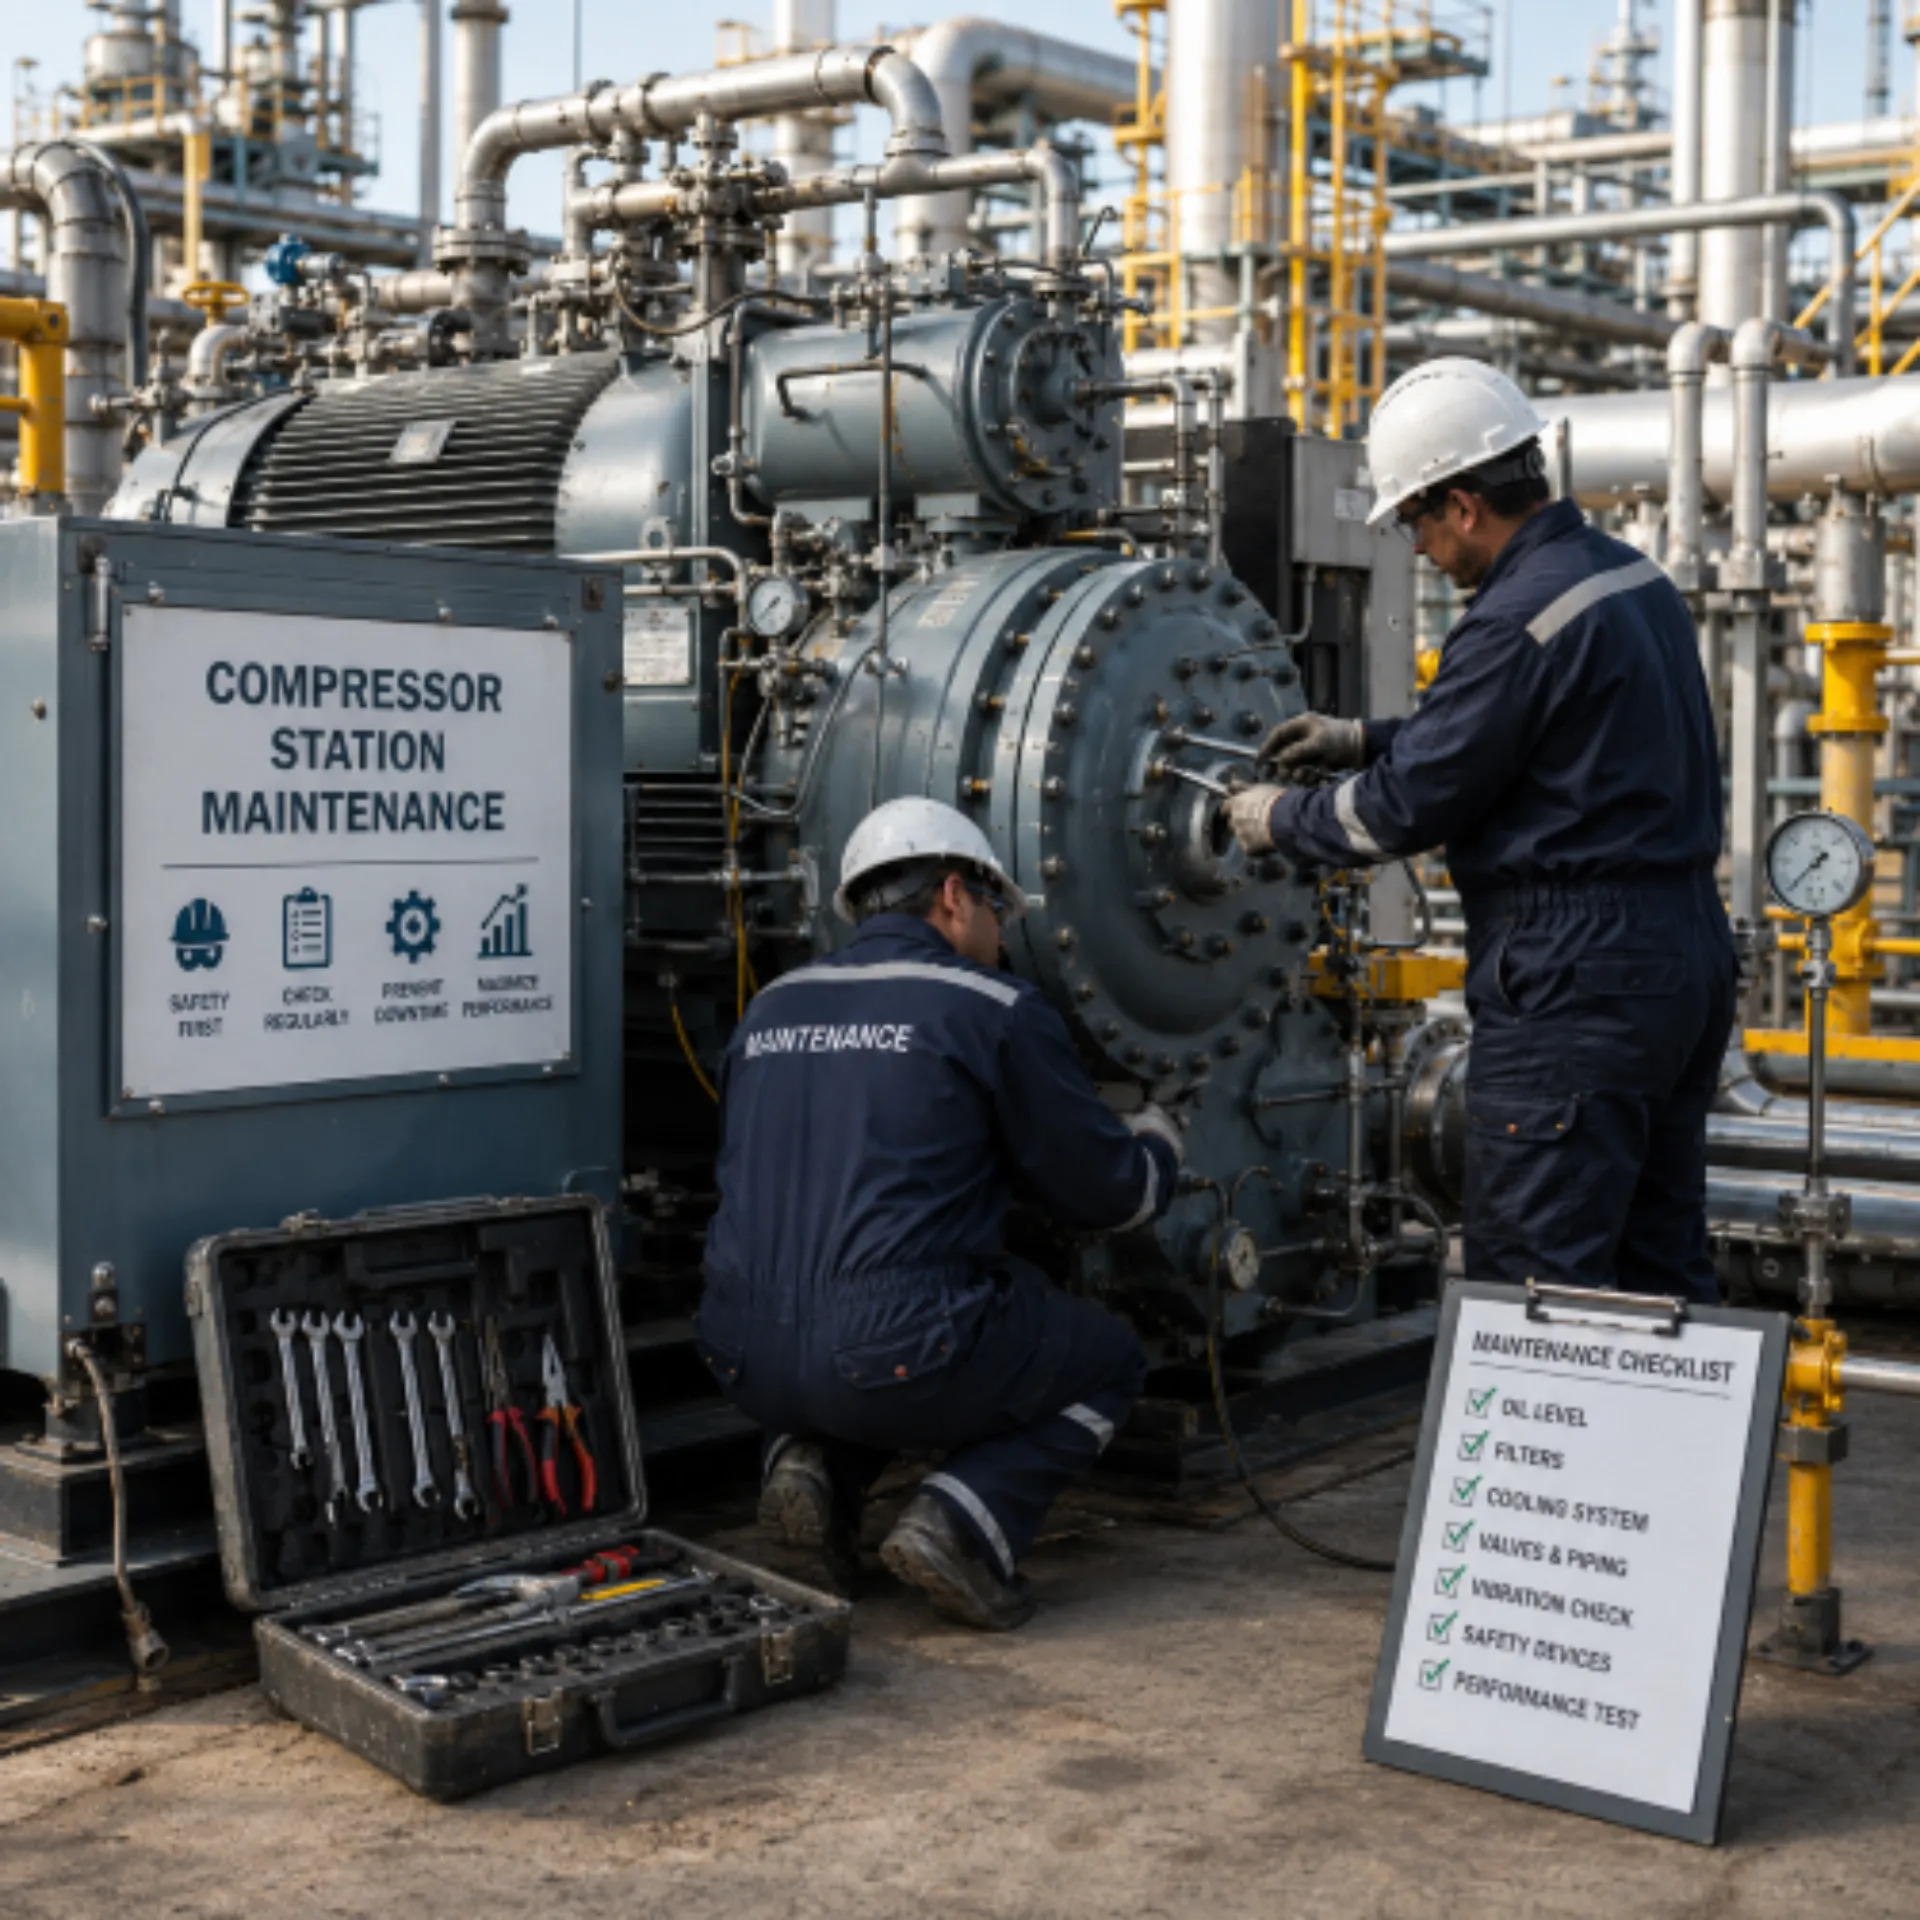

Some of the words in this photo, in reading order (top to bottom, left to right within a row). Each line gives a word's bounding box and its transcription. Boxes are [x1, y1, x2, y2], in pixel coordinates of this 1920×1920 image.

[205, 660, 503, 713] COMPRESSOR
[270, 727, 446, 773] STATION
[201, 790, 506, 835] MAINTENANCE
[168, 990, 230, 1014] SAFETY
[745, 1023, 914, 1060] MAINTENANCE
[1472, 1330, 1615, 1370] MAINTENANCE
[1617, 1349, 1736, 1384] CHECKLIST
[1502, 1397, 1529, 1420] OIL
[1533, 1402, 1588, 1428] LEVEL
[1494, 1441, 1565, 1471] FILTERS
[1487, 1486, 1568, 1519] COOLING
[1572, 1502, 1650, 1533] SYSTEM
[1479, 1532, 1546, 1562] VALVES
[1549, 1545, 1562, 1566] &
[1567, 1548, 1628, 1578] PIPING
[1472, 1577, 1565, 1614] VIBRATION
[1571, 1597, 1634, 1629] CHECK
[1461, 1623, 1531, 1656] SAFETY
[1533, 1639, 1612, 1674] DEVICES
[1453, 1670, 1590, 1720] PERFORMANCE
[1594, 1701, 1642, 1731] TEST
